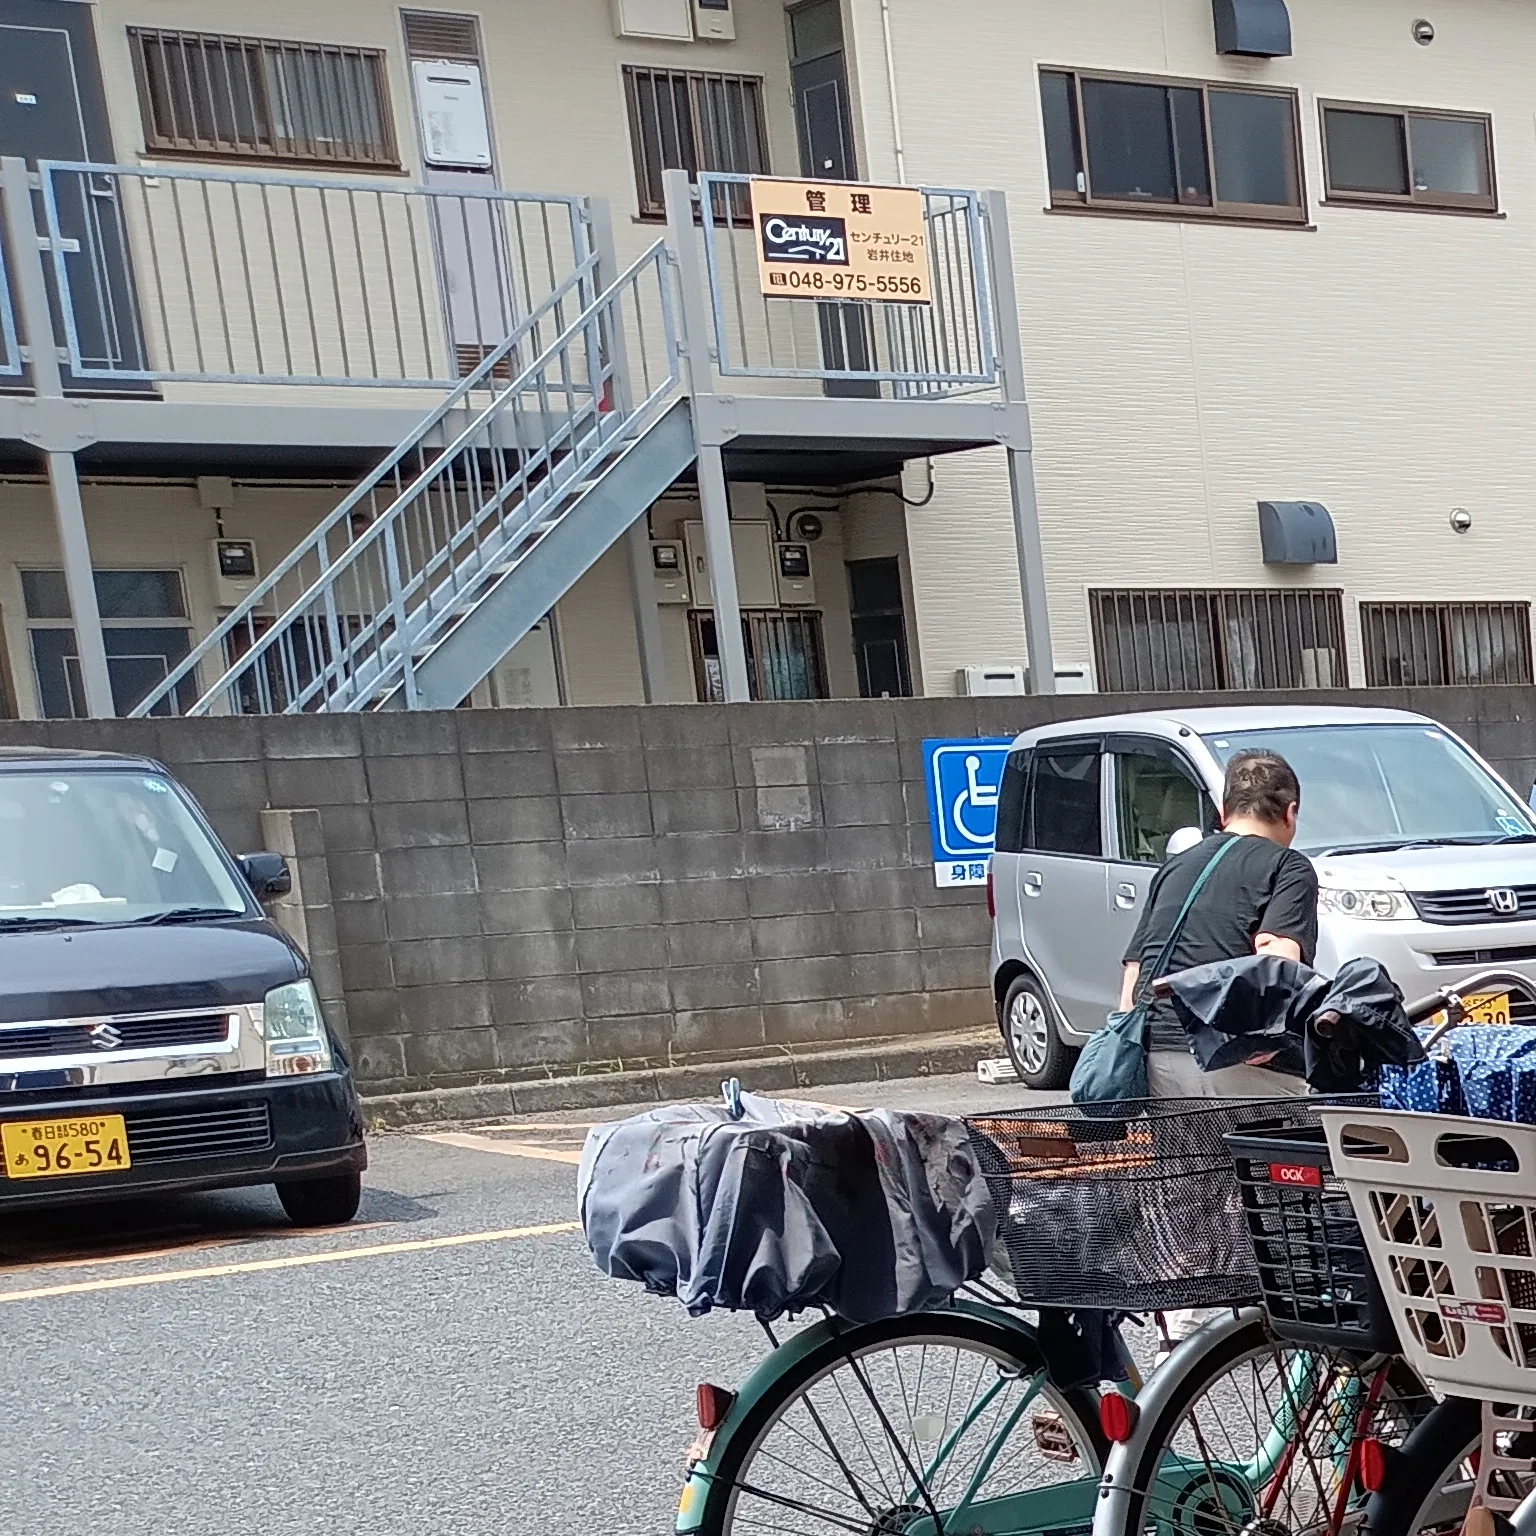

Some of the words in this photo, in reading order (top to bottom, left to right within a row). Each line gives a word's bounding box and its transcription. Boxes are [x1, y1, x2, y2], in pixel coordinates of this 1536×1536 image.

[806, 190, 872, 215] 管理
[765, 218, 832, 246] Century
[825, 237, 845, 261] 21
[850, 231, 924, 246] センチュリー21
[789, 271, 921, 294] 048-975-5556
[950, 864, 985, 881] 身障
[14, 1152, 30, 1167] あ
[33, 1137, 123, 1172] 96-54
[1280, 1167, 1305, 1181] OGK
